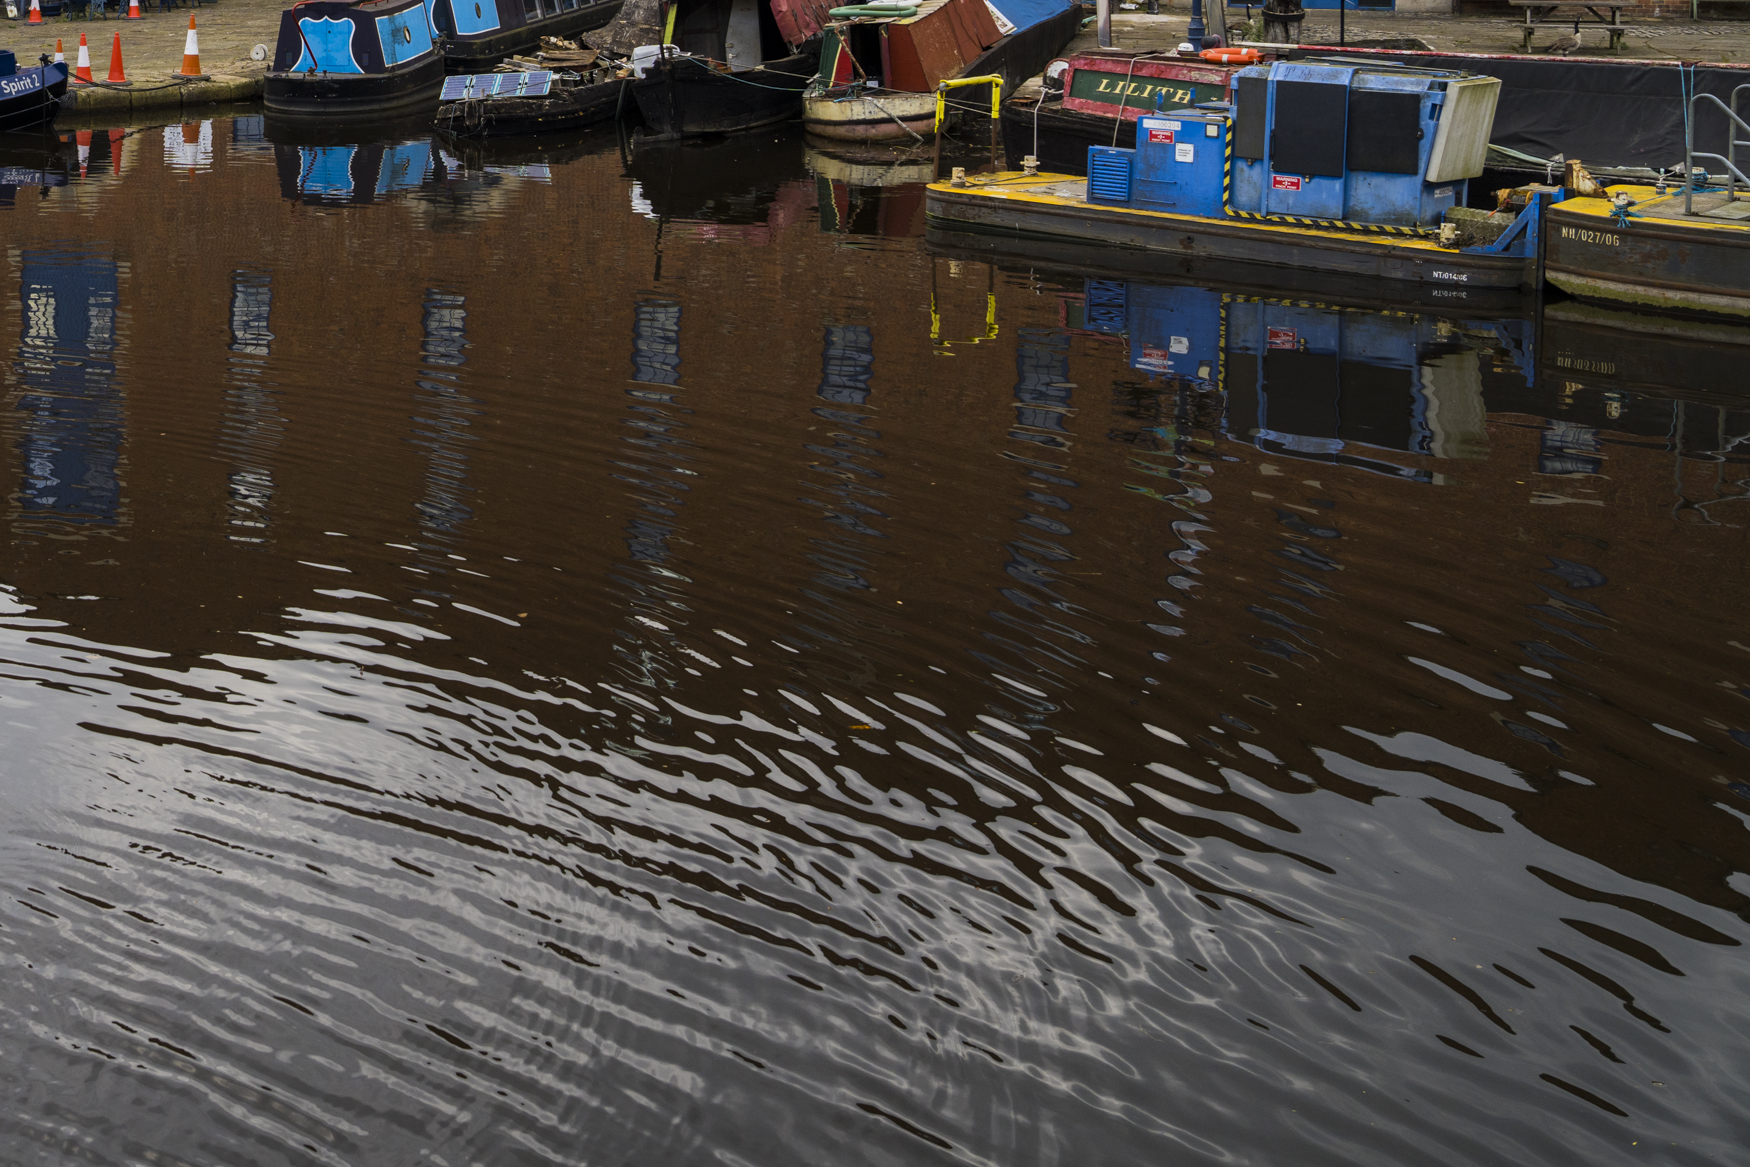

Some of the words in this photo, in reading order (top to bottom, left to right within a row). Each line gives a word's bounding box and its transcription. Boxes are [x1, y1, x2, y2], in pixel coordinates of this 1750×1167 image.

[1, 76, 33, 95] Spirit
[32, 74, 40, 87] 2
[1096, 78, 1191, 104] LILITH
